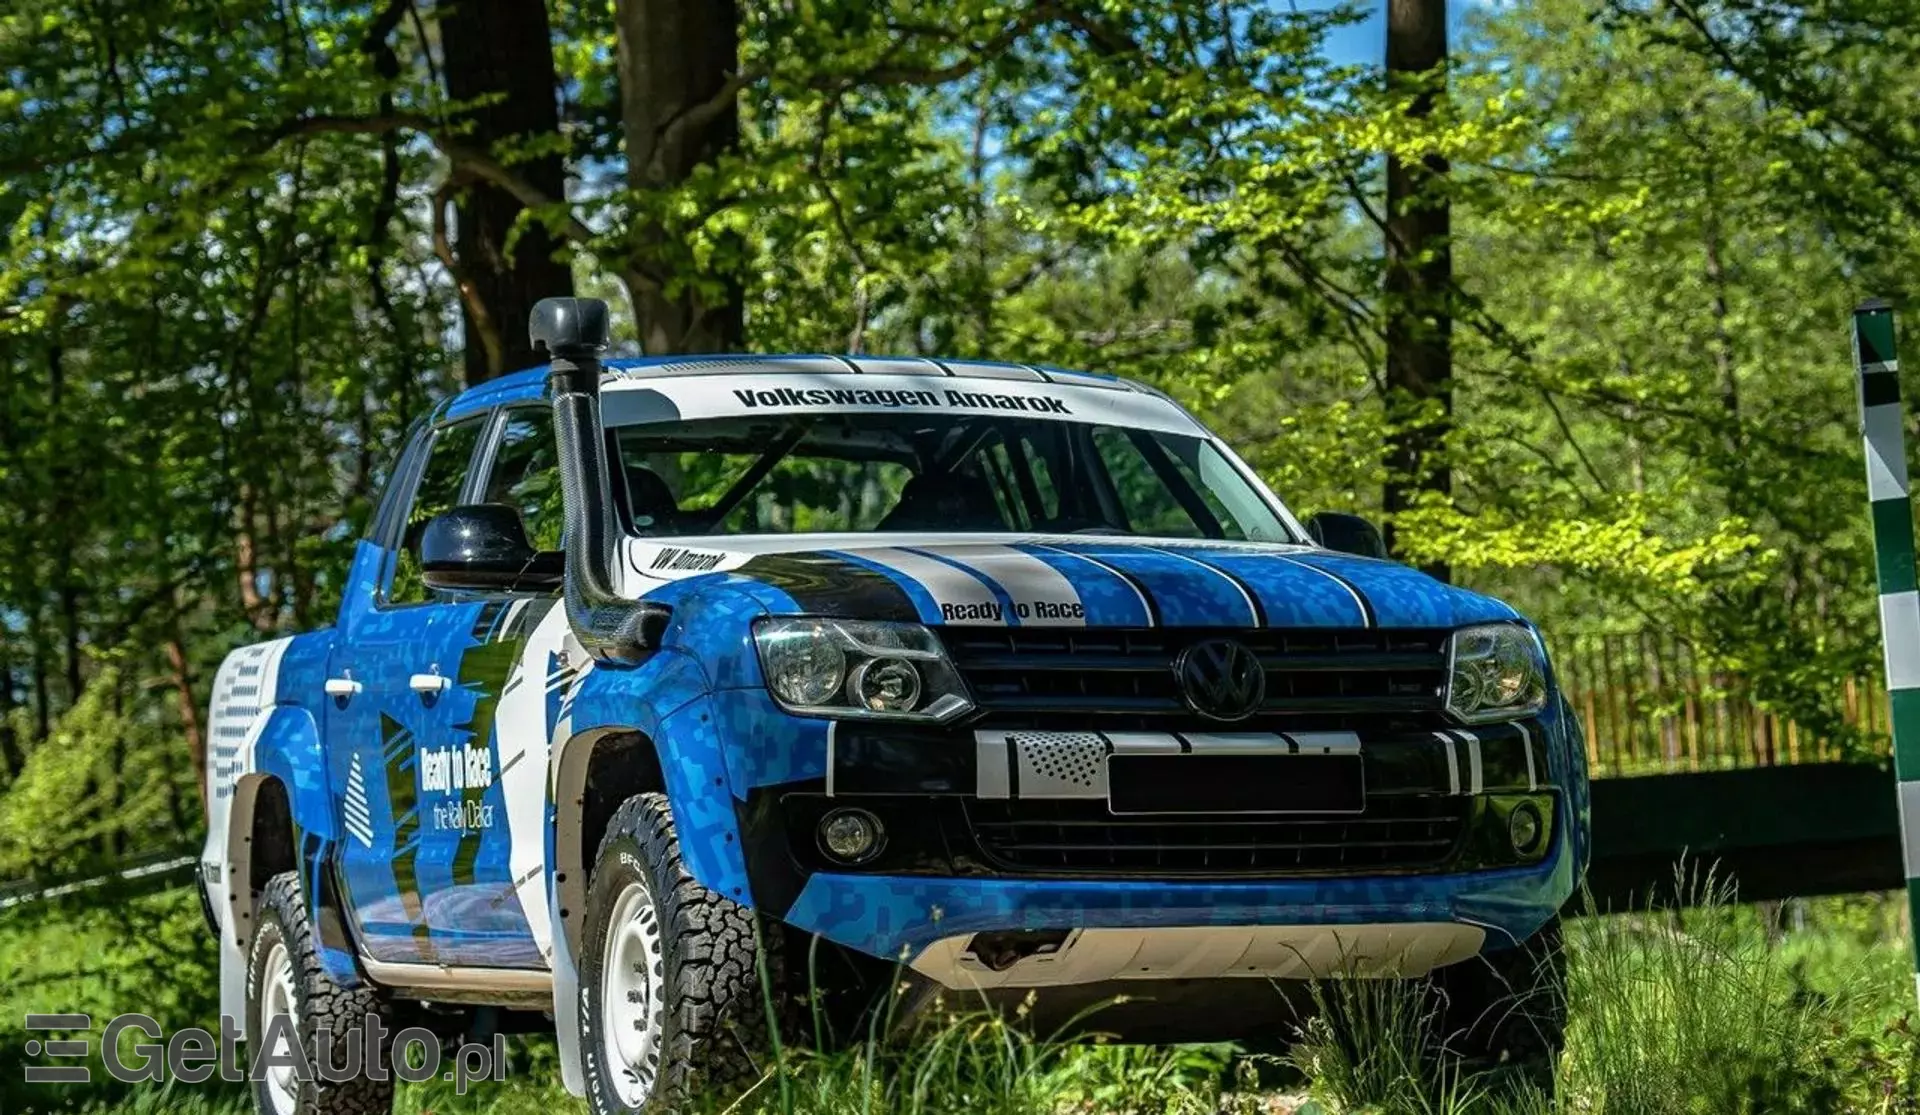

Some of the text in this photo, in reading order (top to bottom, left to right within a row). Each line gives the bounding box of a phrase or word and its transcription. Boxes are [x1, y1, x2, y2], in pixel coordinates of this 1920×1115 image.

[733, 388, 1074, 415] Volkswagen Amarok
[649, 547, 727, 571] VW Amarok
[941, 602, 1002, 621] Ready
[1035, 601, 1085, 619] Race
[421, 743, 492, 796] Ready to Race
[434, 803, 448, 829] the
[466, 799, 494, 829] Dakar
